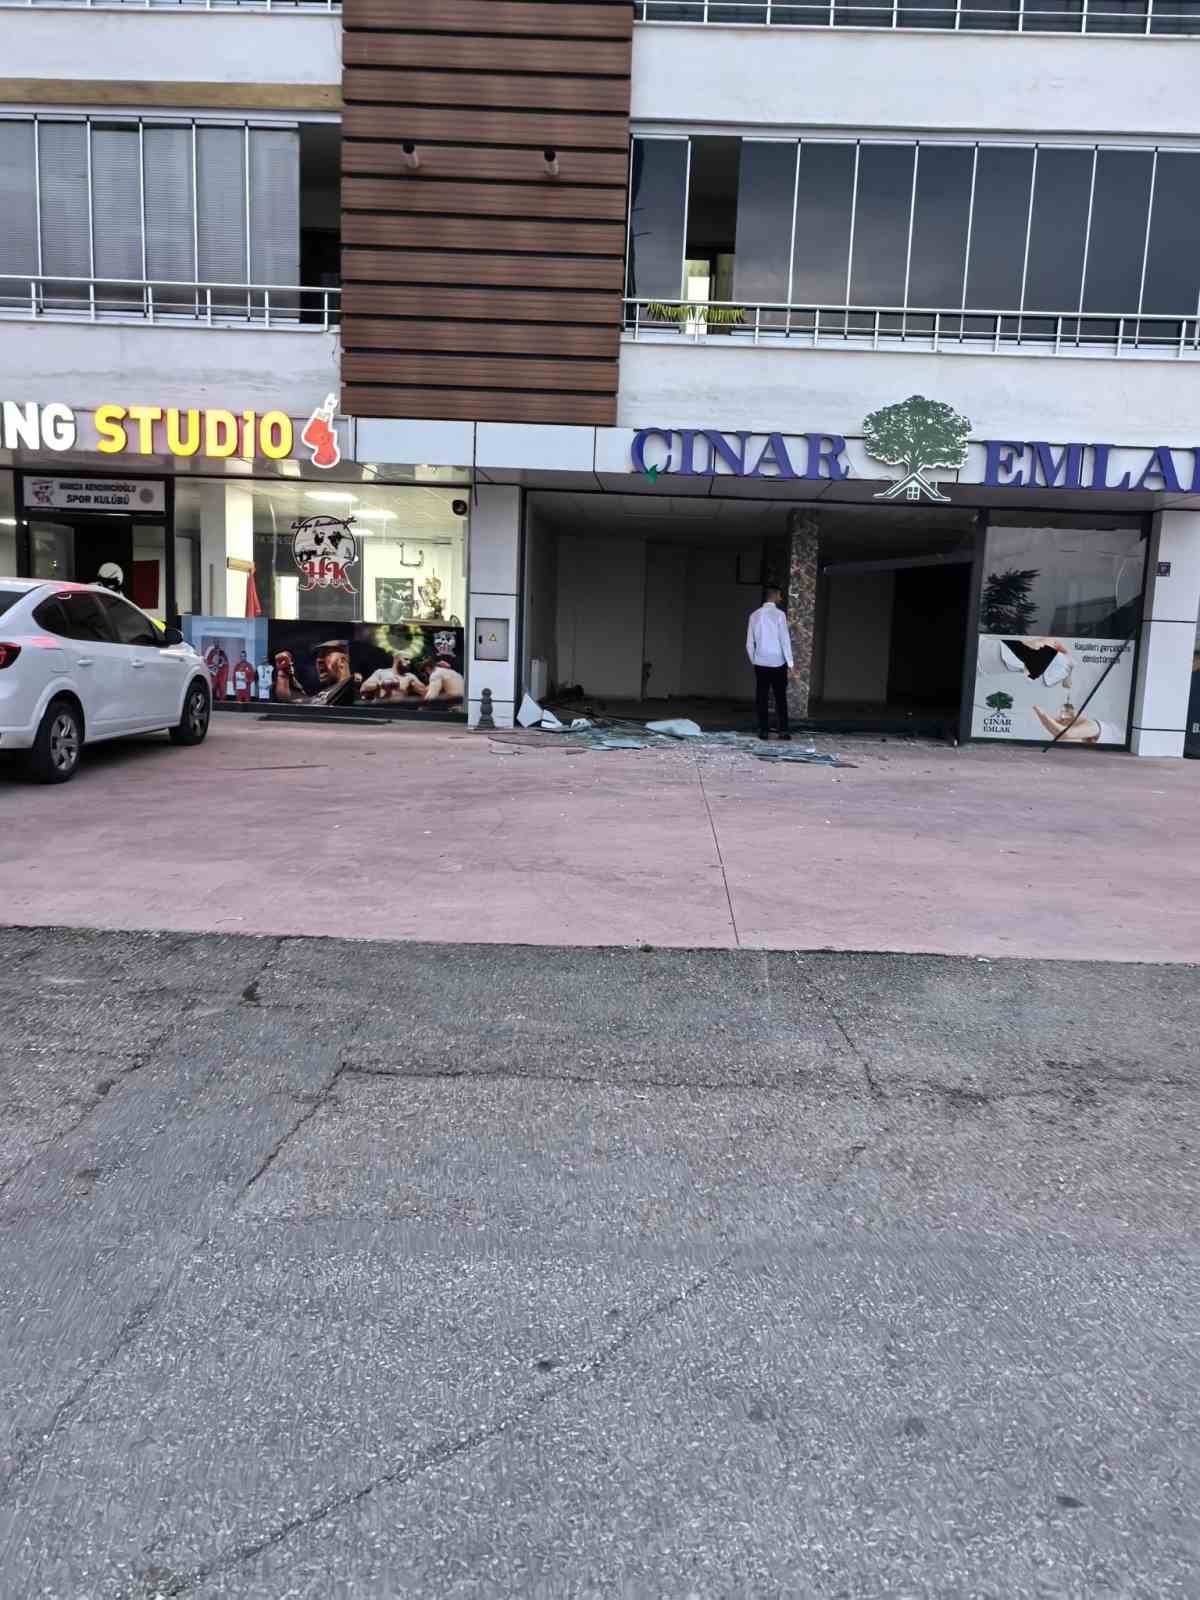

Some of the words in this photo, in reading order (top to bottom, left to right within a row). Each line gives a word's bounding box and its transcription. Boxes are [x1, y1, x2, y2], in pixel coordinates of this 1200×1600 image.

[0, 400, 76, 451] NG
[980, 440, 1200, 493] EMLA
[66, 494, 91, 504] SPOR
[93, 494, 130, 505] KULÜBÜ
